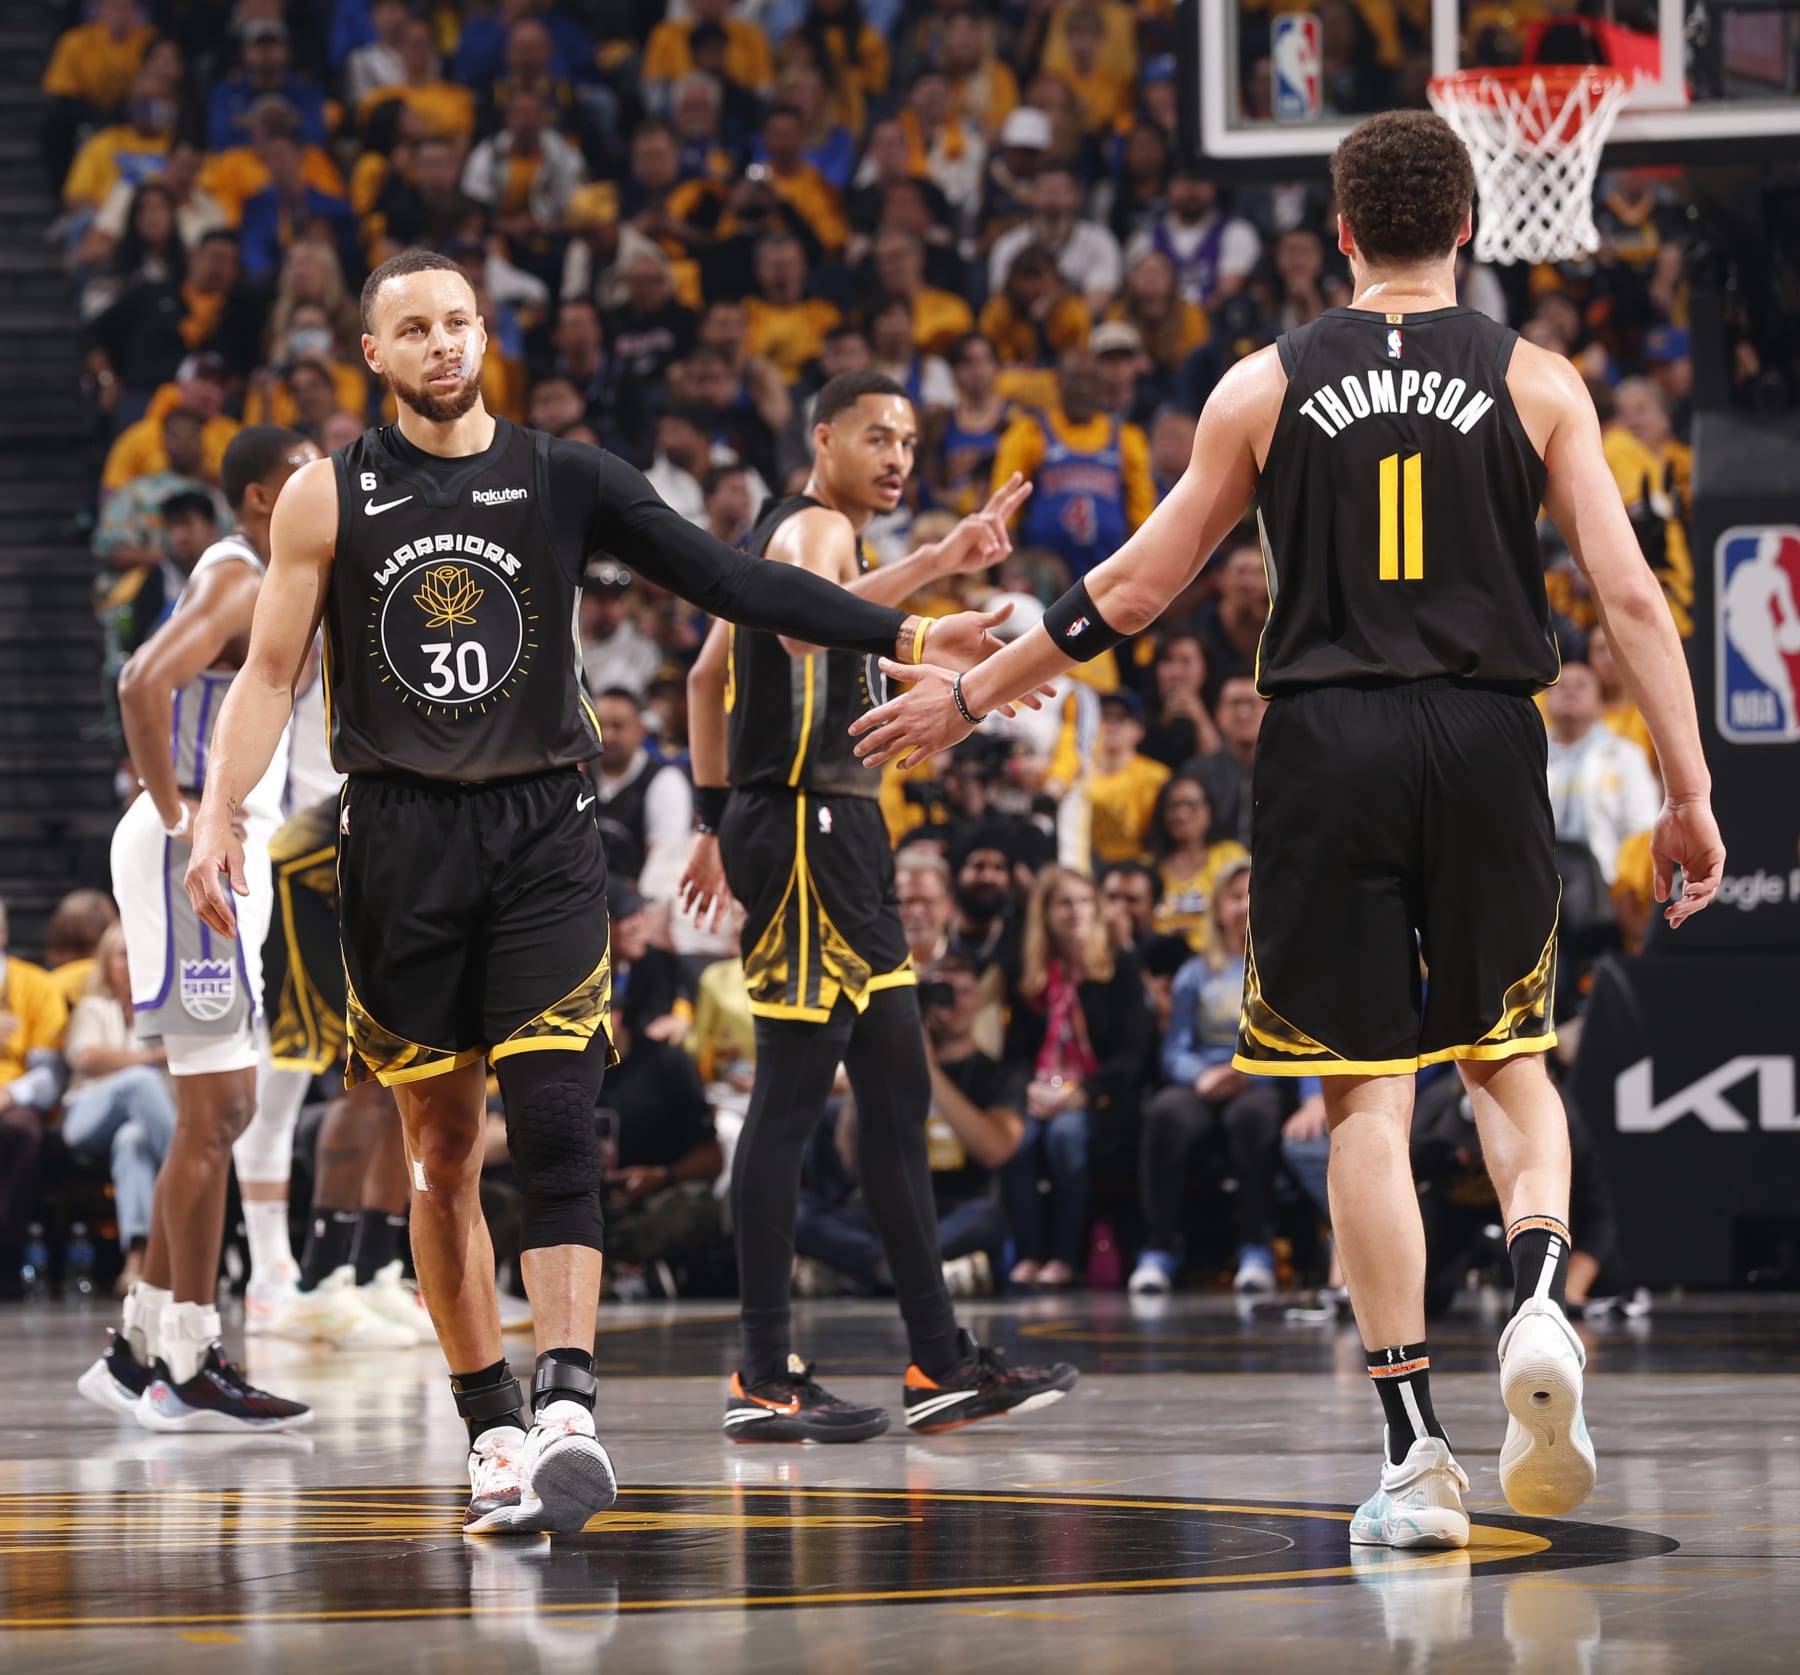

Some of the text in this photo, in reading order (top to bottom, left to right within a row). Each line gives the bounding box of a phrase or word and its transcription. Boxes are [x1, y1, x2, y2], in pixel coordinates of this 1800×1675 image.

[1299, 369, 1494, 438] THOMPSON
[360, 472, 377, 491] 6
[472, 487, 528, 504] Rakuten
[1379, 452, 1423, 580] 11
[373, 534, 522, 586] WARRIORS
[420, 641, 489, 697] 30
[1614, 1055, 1800, 1133] KI
